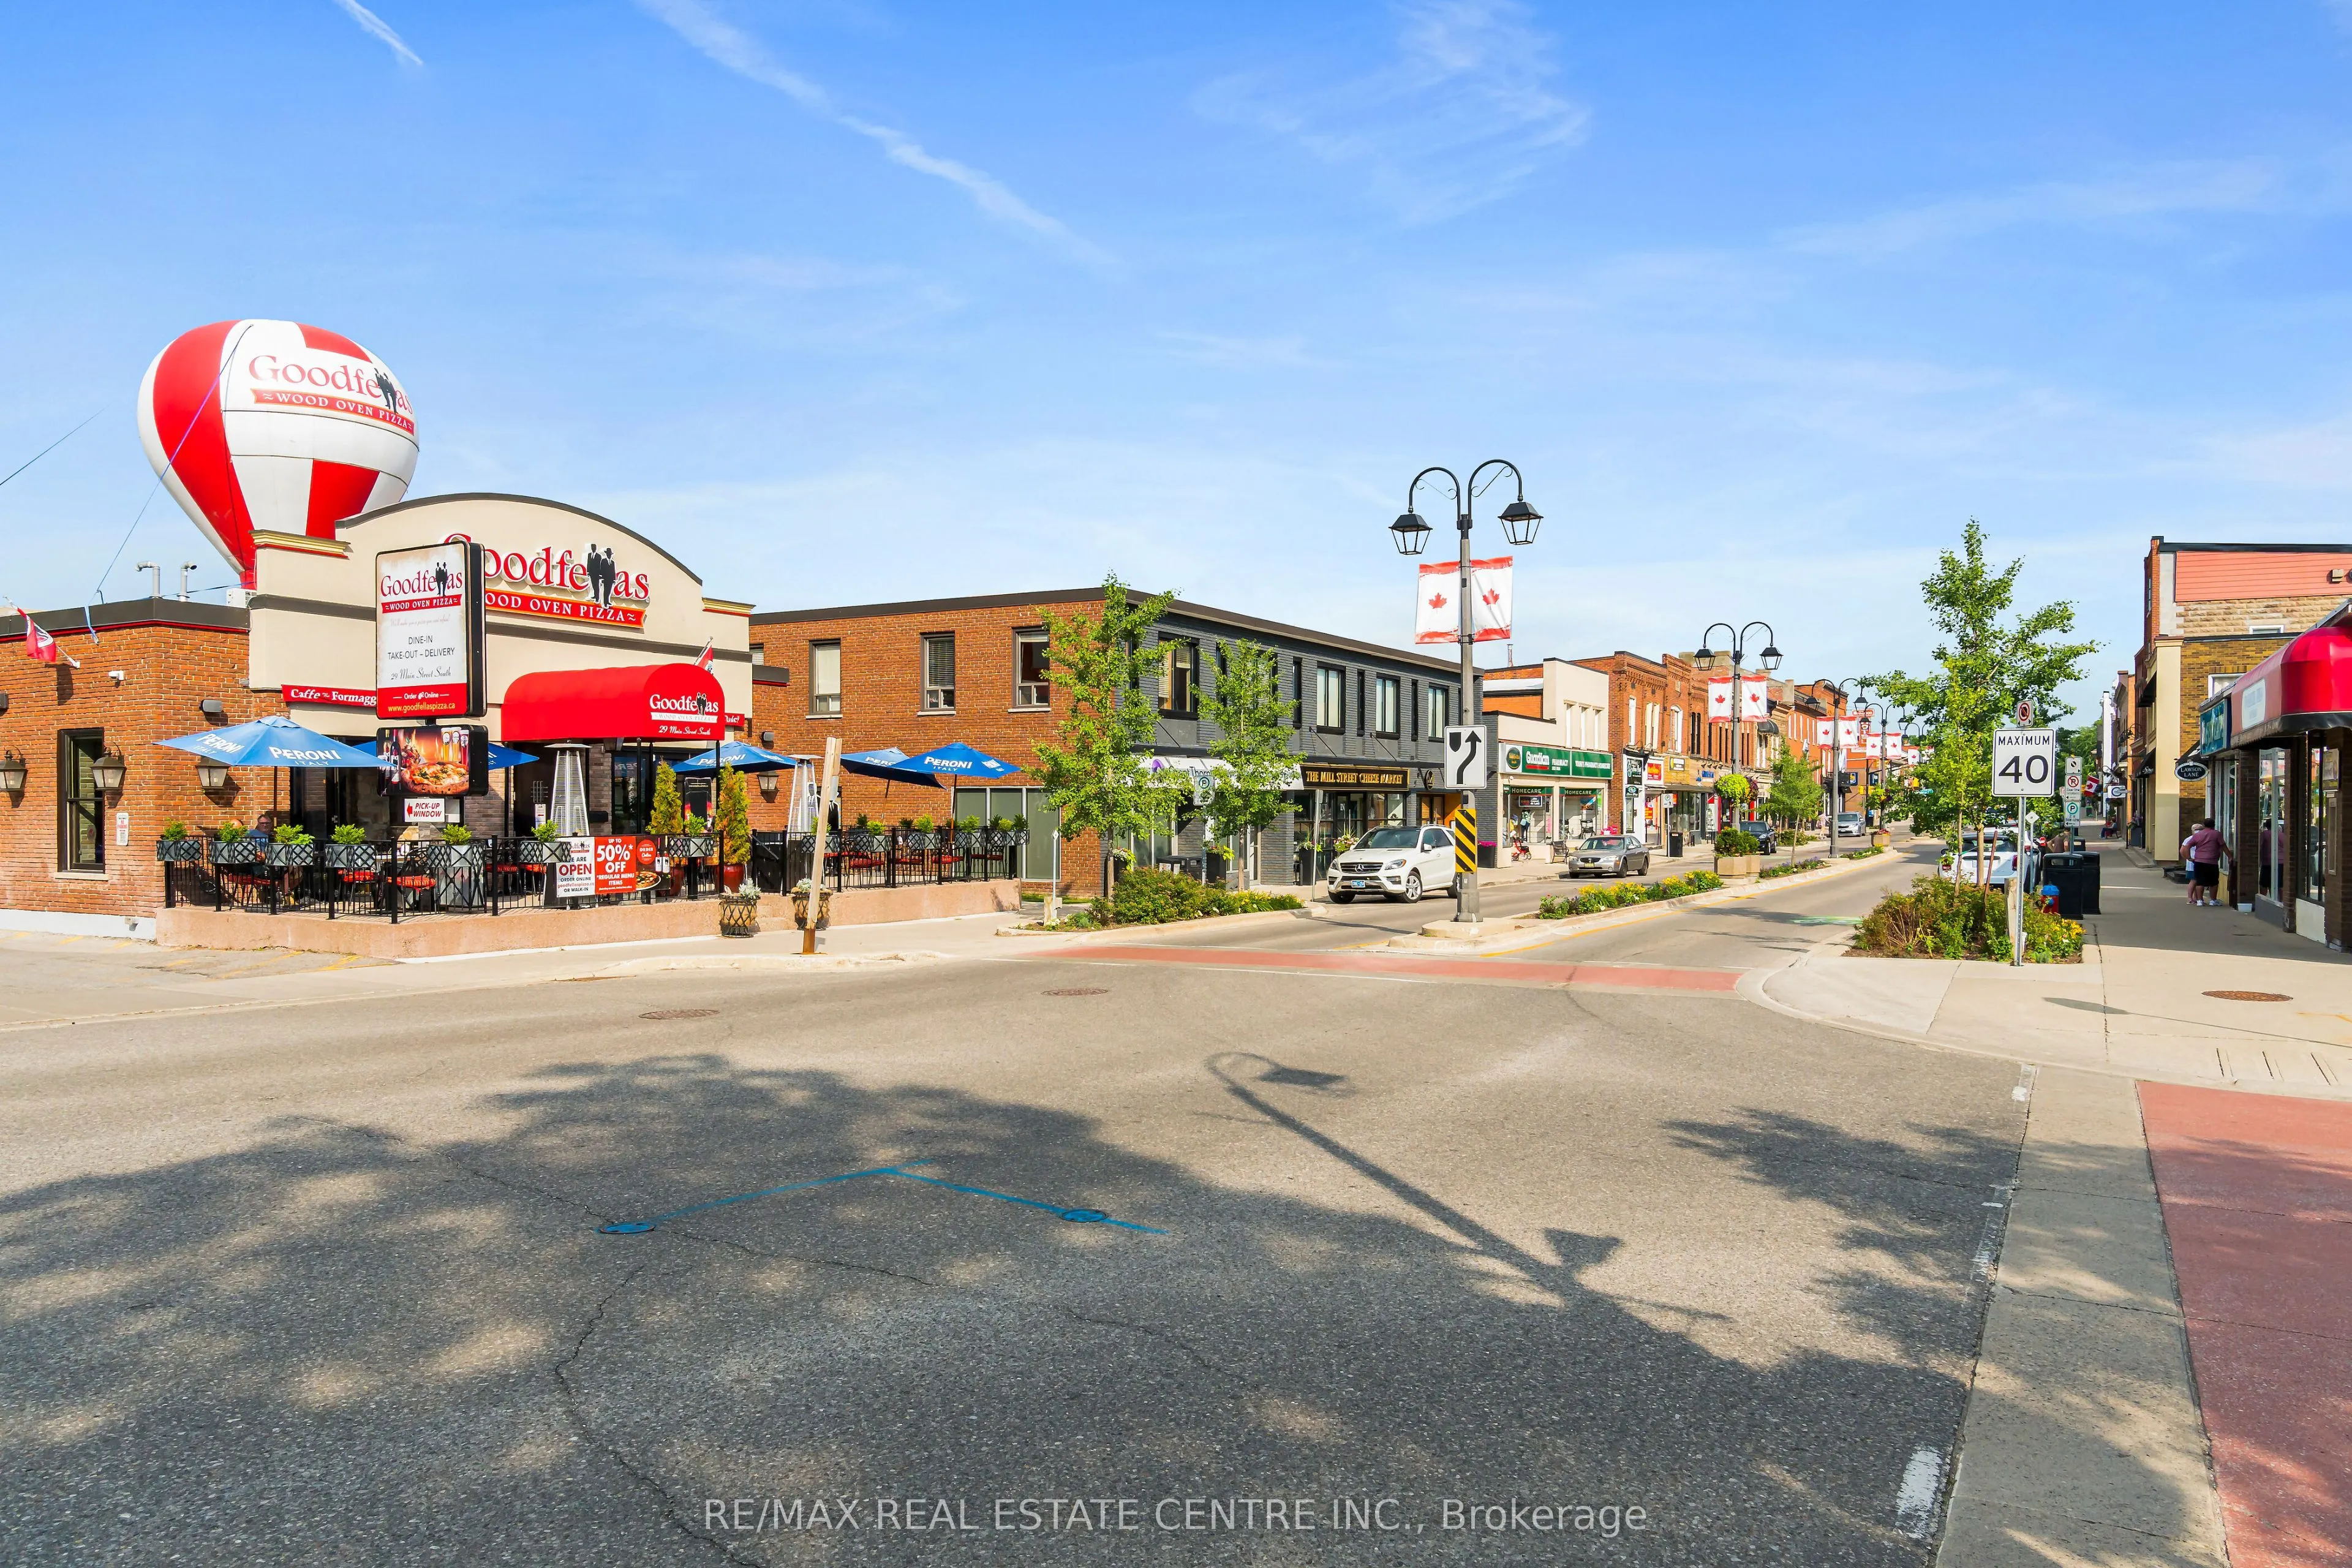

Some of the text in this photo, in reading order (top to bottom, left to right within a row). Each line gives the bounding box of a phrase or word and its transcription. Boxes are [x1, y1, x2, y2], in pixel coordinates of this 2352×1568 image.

[249, 355, 413, 414] Goodfeas
[277, 393, 408, 428] WOOD OVEN PIZZA
[444, 533, 649, 600] oodfeas
[380, 570, 463, 597] Goodfeas
[390, 603, 410, 611] WOOD
[433, 598, 453, 606] PIZZA
[485, 592, 625, 622] OOD OVEN PIZZA
[408, 635, 433, 645] DINE-IN
[388, 650, 418, 660] TAKE-OUT
[424, 647, 455, 658] DELIVERY
[399, 668, 415, 680] Main
[416, 666, 433, 679] Street
[434, 665, 451, 677] South
[290, 688, 377, 706] Caffe Formagg
[650, 694, 719, 713] Goodfeas
[388, 701, 456, 714] www.goodfellaspizza.ca
[669, 725, 682, 734] Main
[683, 726, 697, 735] Street
[196, 733, 244, 754] PERONI
[1998, 736, 2050, 746] MAXIMUM
[193, 745, 217, 755] ITALY
[269, 746, 342, 760] PERONI
[924, 756, 973, 769] PERONI
[1999, 755, 2049, 783] 40
[1306, 771, 1403, 784] THE MILL STREET CHEESE MARKET
[559, 863, 592, 876] OPEN
[605, 861, 626, 873] OFF
